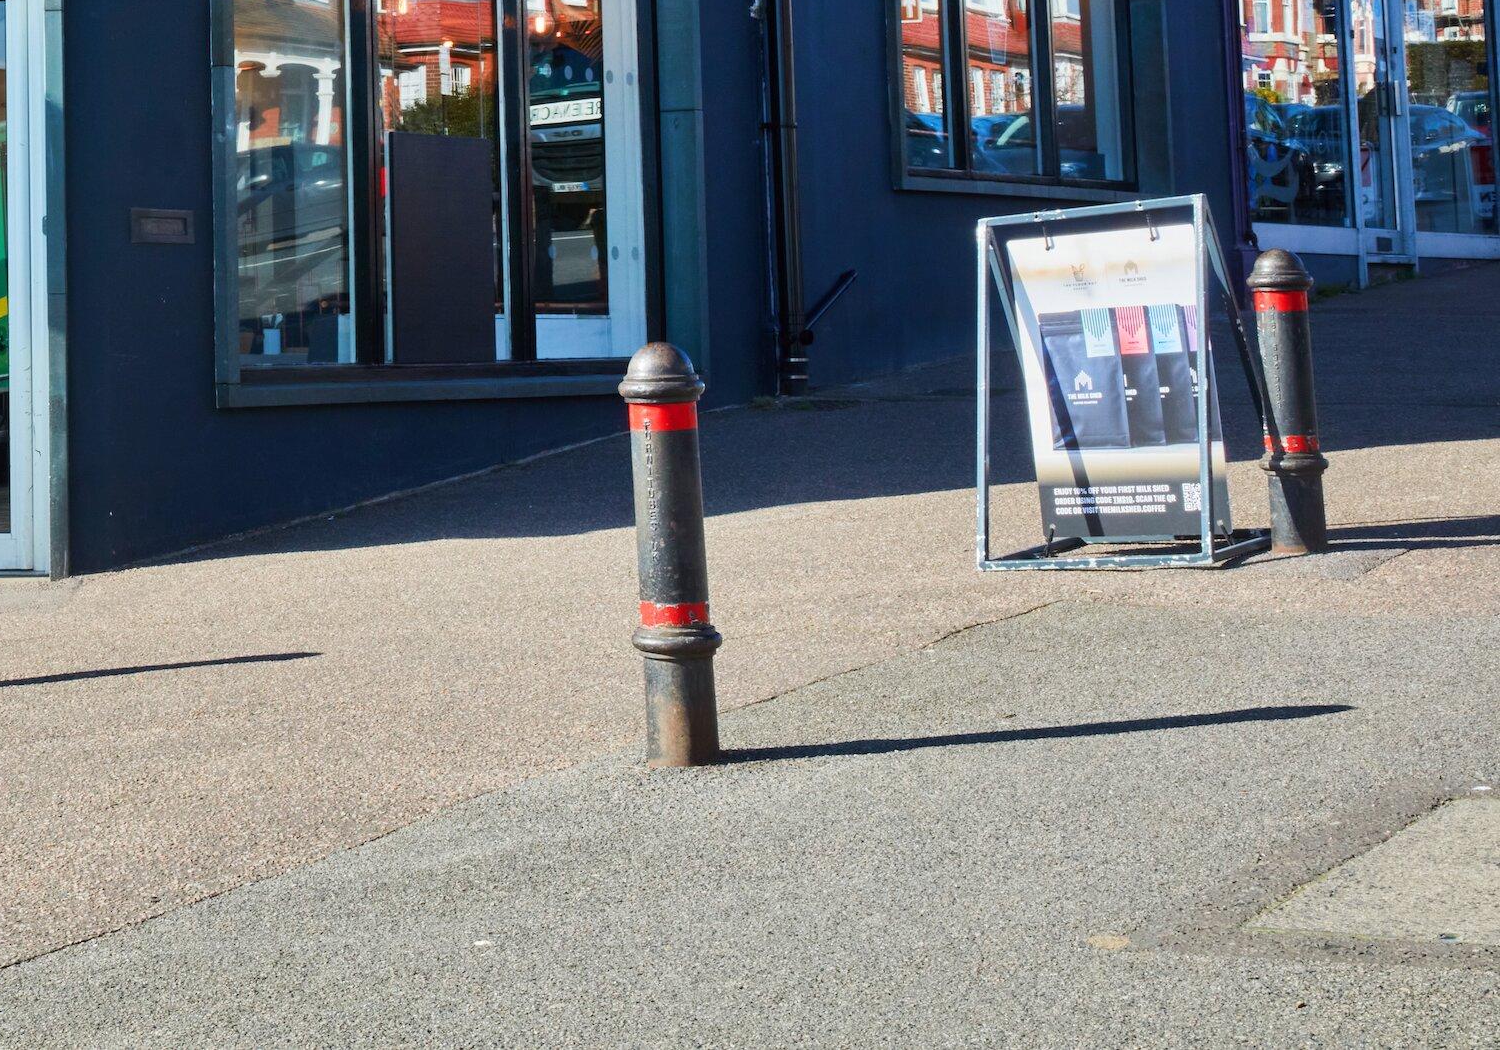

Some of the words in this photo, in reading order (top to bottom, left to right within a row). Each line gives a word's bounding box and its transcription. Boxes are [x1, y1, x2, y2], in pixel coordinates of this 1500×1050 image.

[1053, 487, 1073, 495] ENJOY
[1073, 487, 1087, 495] 10%
[1088, 486, 1099, 494] OFF
[1100, 486, 1117, 494] YOUR
[1117, 485, 1135, 493] FIRST
[1152, 484, 1169, 492] SHED
[1054, 497, 1075, 505] ORDER
[1076, 496, 1095, 504] USING
[1095, 496, 1112, 504] CODE
[1135, 495, 1153, 503] SCAN
[1153, 494, 1166, 502] THE
[1166, 494, 1176, 503] QR
[1056, 507, 1073, 515] CODE
[1082, 506, 1098, 514] VISIT
[1099, 504, 1167, 514] THEMILKSHED.COFFEE
